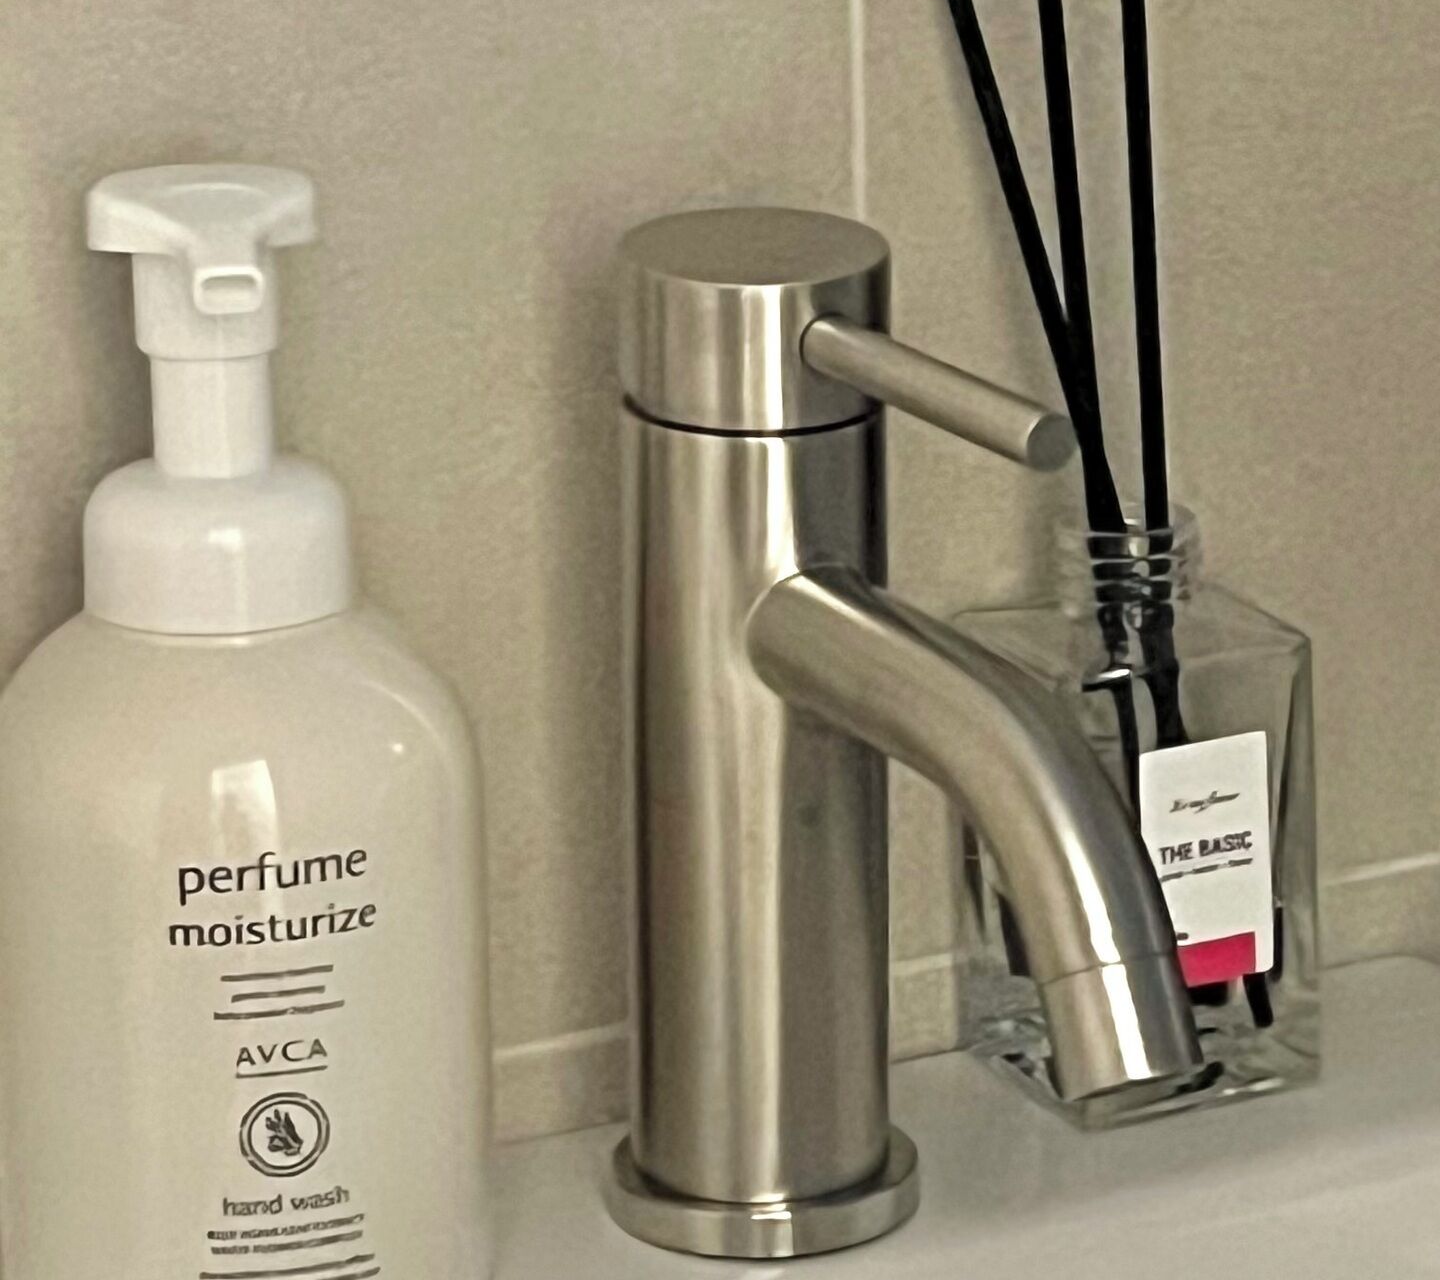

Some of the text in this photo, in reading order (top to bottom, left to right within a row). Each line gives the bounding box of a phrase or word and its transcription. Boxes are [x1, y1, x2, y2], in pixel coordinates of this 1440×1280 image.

[1158, 830, 1253, 865] THE BASIC
[178, 849, 368, 905] perfume
[169, 903, 377, 946] moisturize
[236, 1038, 328, 1068] AVCA
[223, 1187, 350, 1217] hand wash
